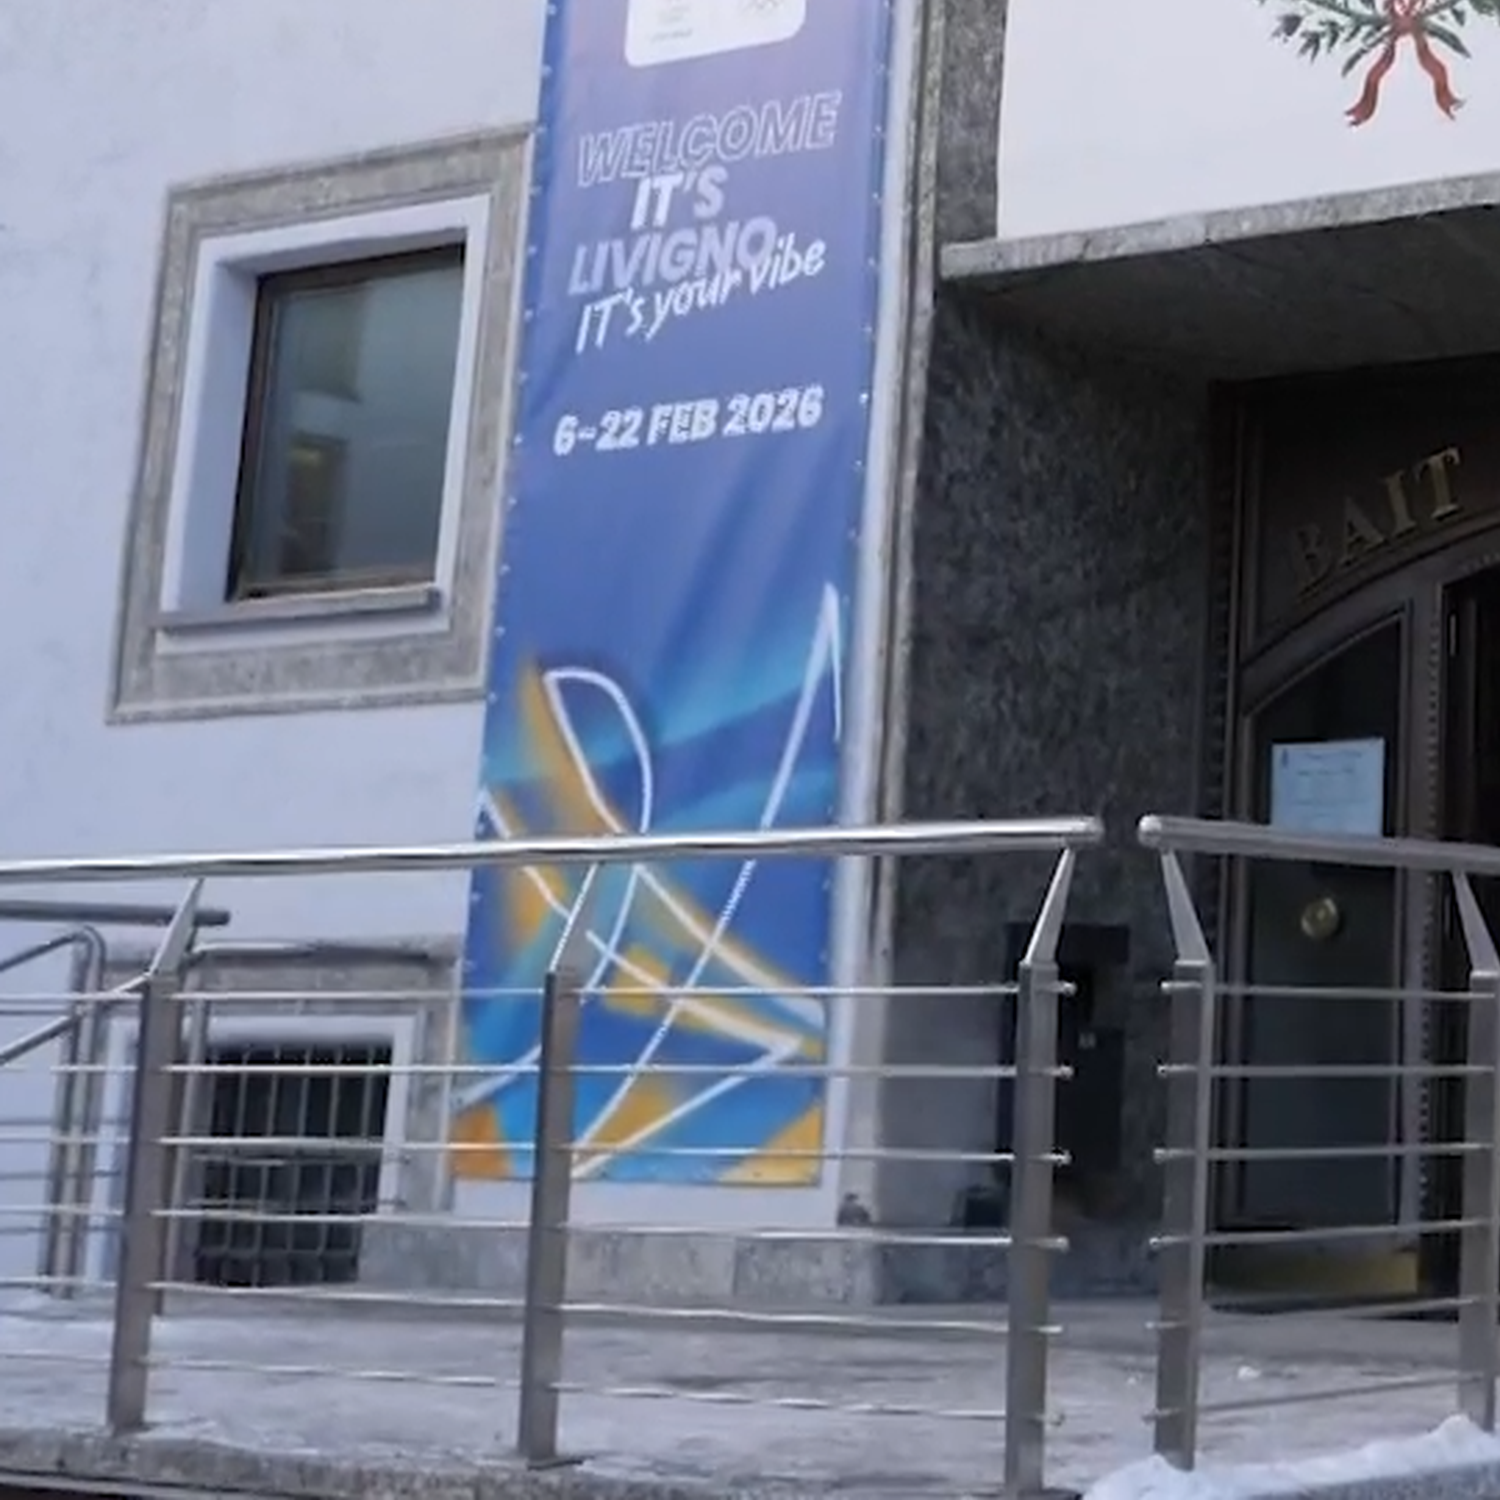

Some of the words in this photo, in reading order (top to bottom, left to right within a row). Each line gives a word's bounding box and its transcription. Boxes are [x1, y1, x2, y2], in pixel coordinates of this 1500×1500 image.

[577, 90, 842, 188] WELCOME
[630, 165, 728, 230] IT'S
[567, 216, 776, 296] LIVIGNO
[645, 267, 743, 342] your
[748, 232, 827, 295] vibe
[646, 399, 719, 446] FEB
[721, 384, 824, 437] 2026
